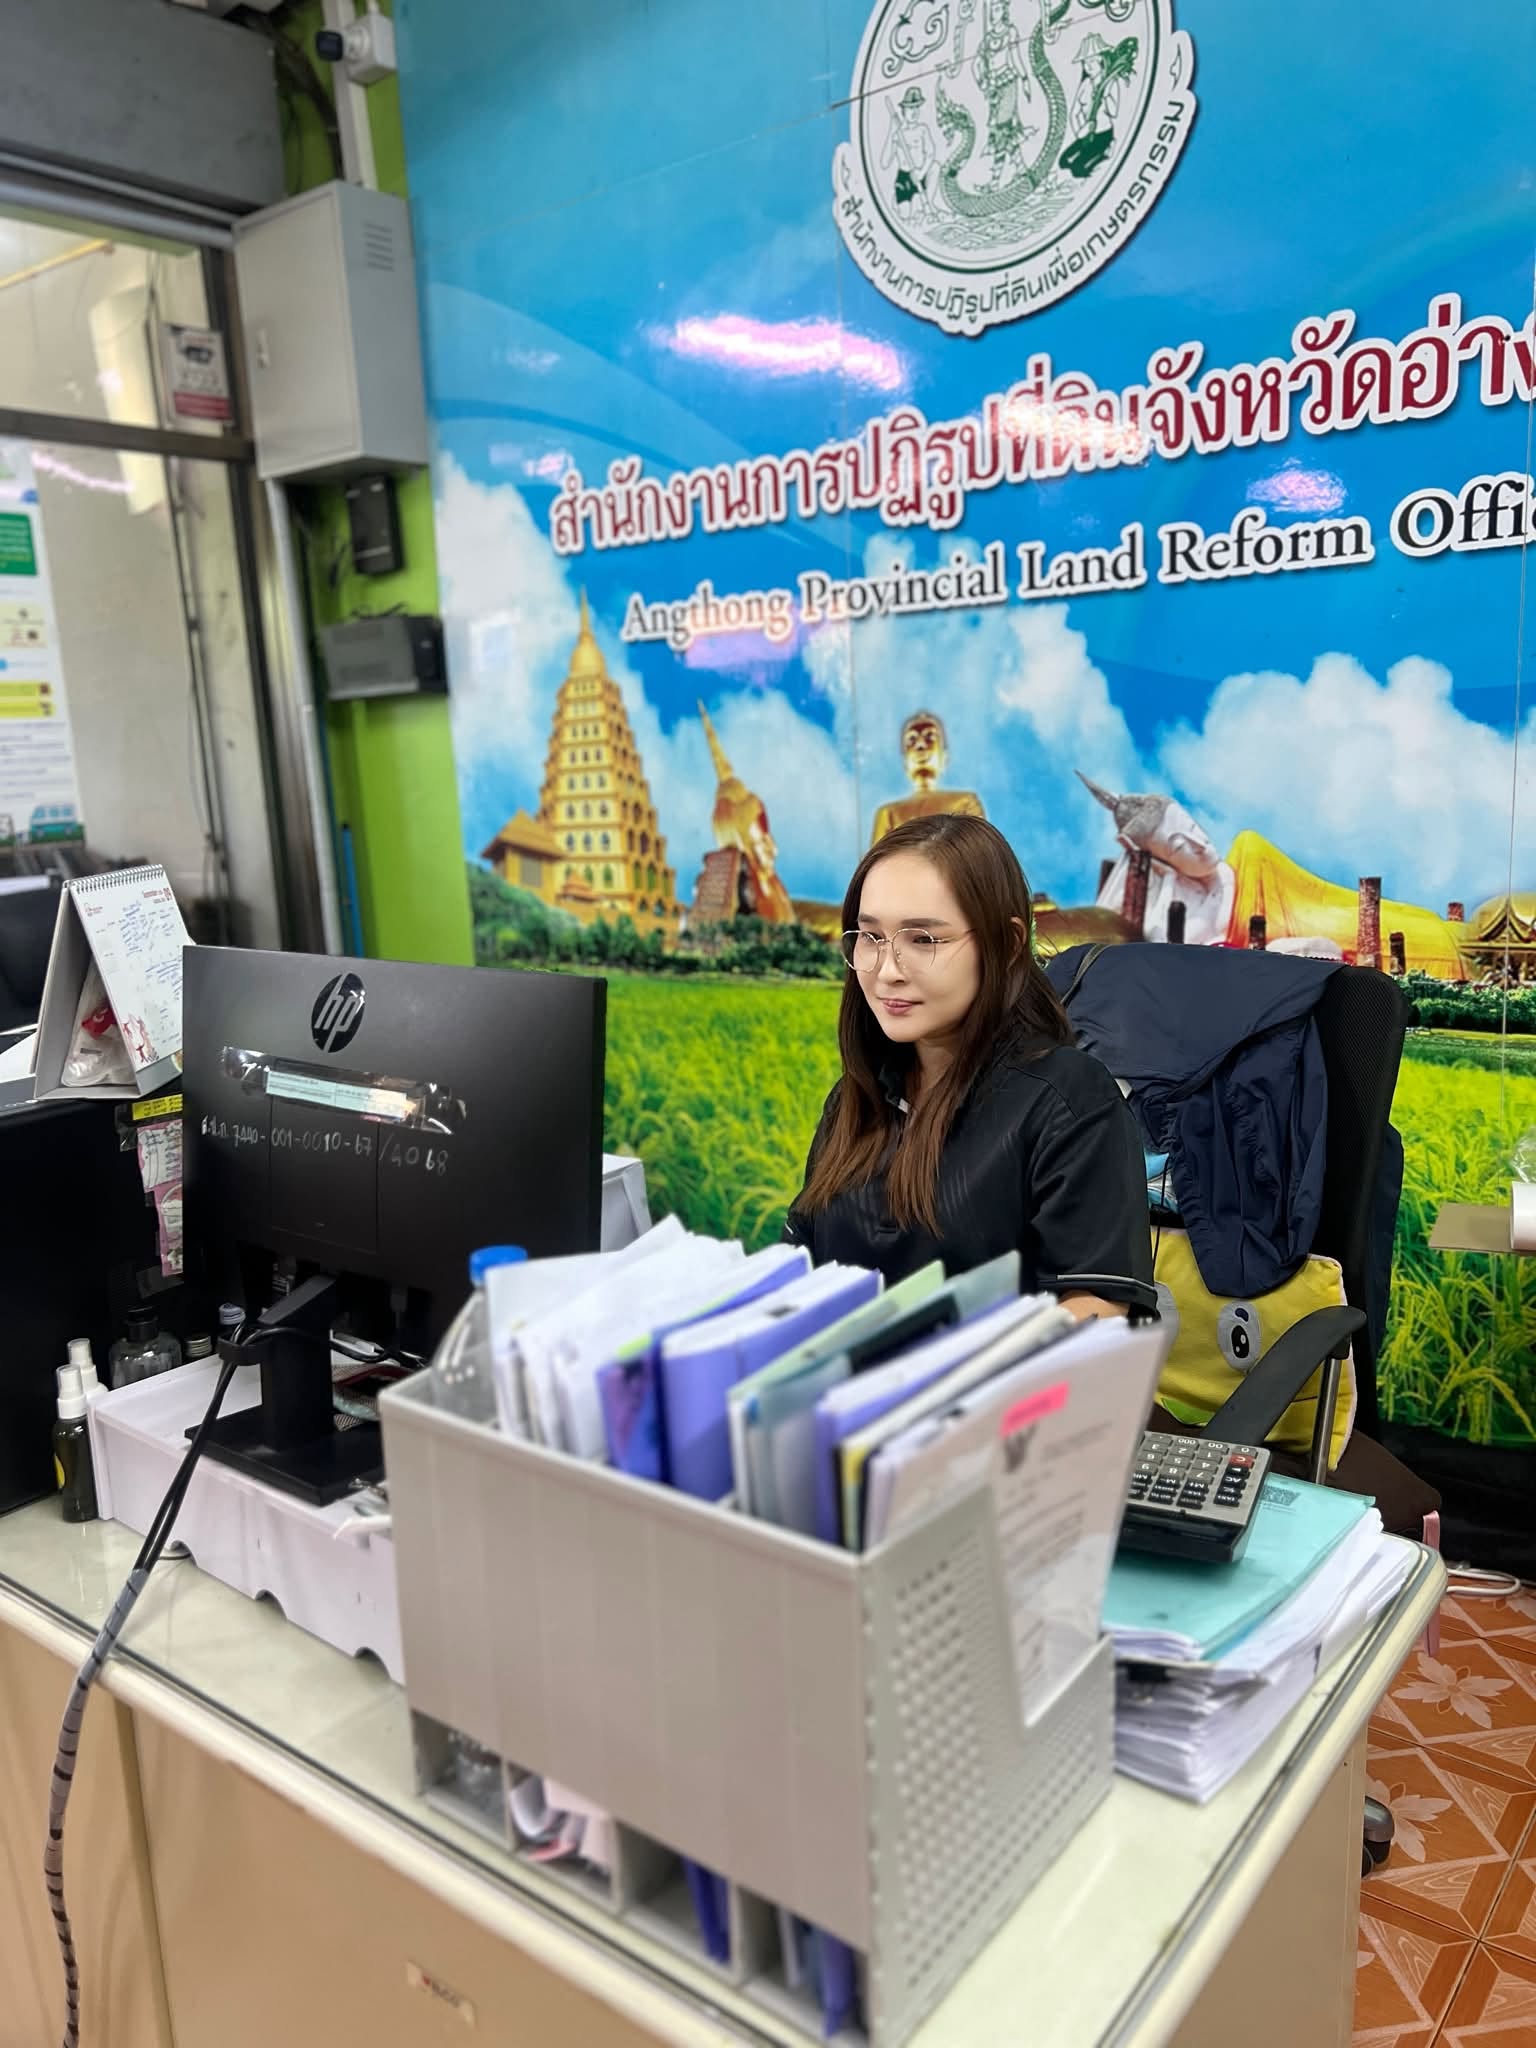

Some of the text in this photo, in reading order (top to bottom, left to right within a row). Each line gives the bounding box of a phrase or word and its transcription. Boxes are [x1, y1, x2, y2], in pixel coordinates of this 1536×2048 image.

[841, 100, 1185, 323] สำนักงานการปฏิรูปที่ดินเพื่อเกษตรกรรม
[626, 479, 1536, 646] Angthong Provincial Land Reform Offi
[1168, 1467, 1178, 1475] 8
